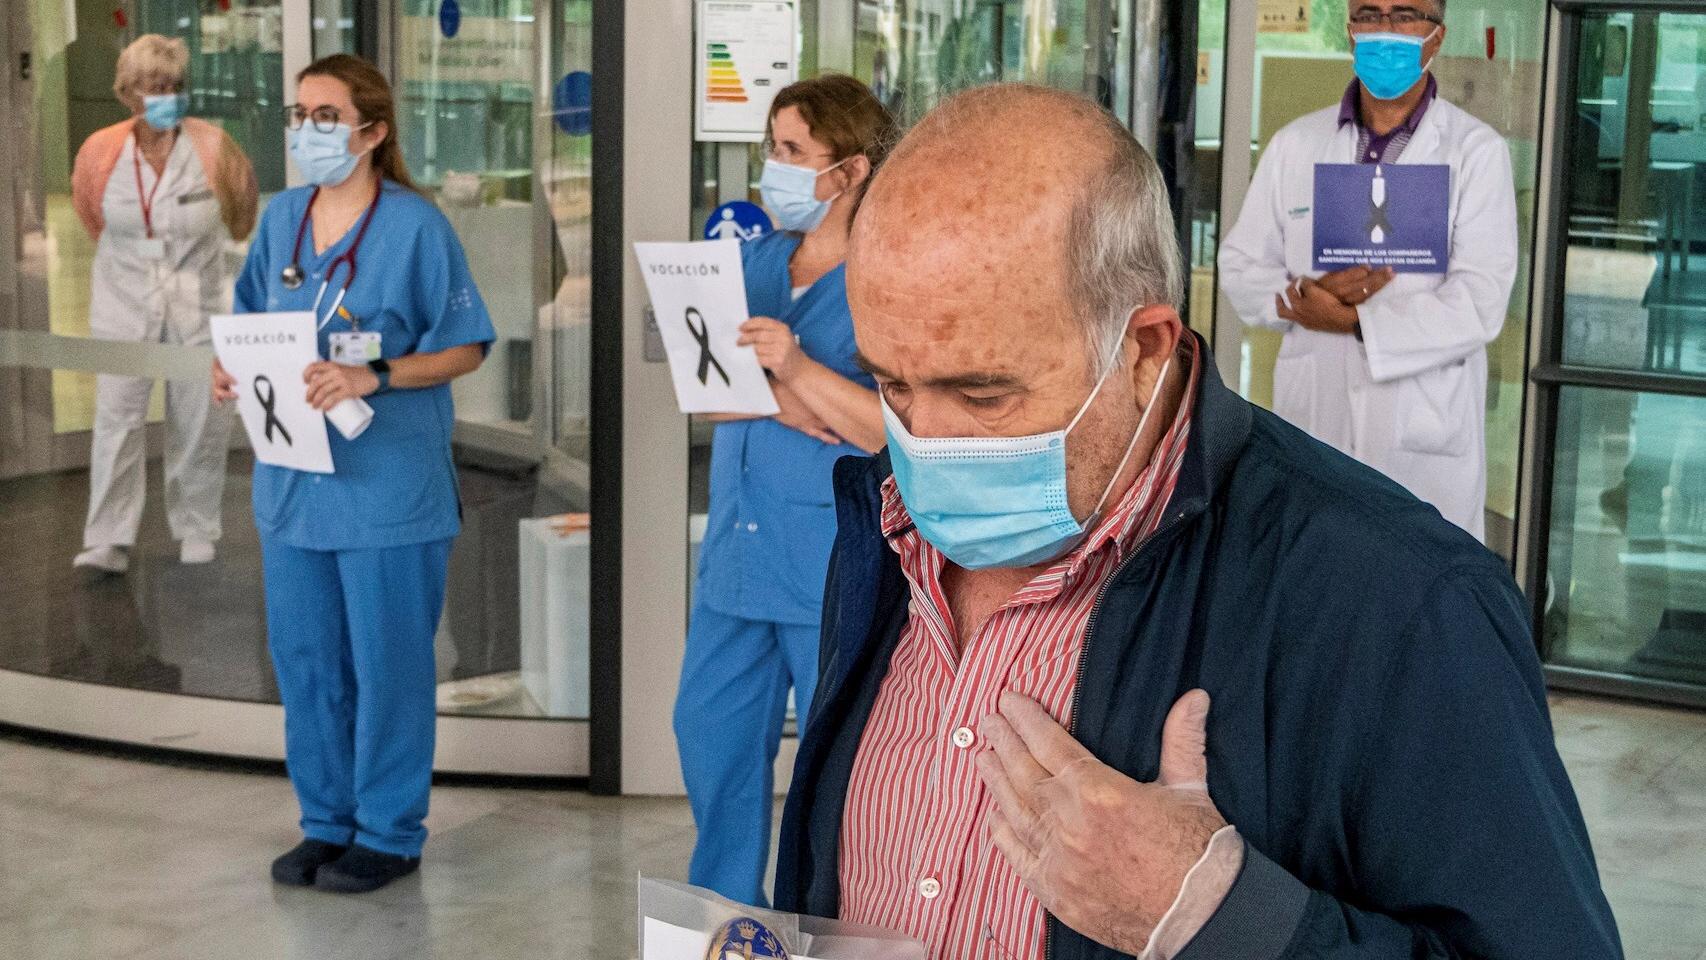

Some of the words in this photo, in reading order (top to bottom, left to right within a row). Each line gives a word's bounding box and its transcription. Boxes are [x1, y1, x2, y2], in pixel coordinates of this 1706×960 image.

[1322, 248, 1332, 256] EN
[1333, 248, 1362, 256] MEMORIA
[1373, 249, 1387, 257] LOS
[1354, 256, 1369, 265] QUE
[1369, 257, 1384, 265] NOS
[1405, 257, 1436, 265] DEJANDO
[649, 262, 720, 276] VOCACIÓN
[224, 331, 296, 345] VOCACIÓN
